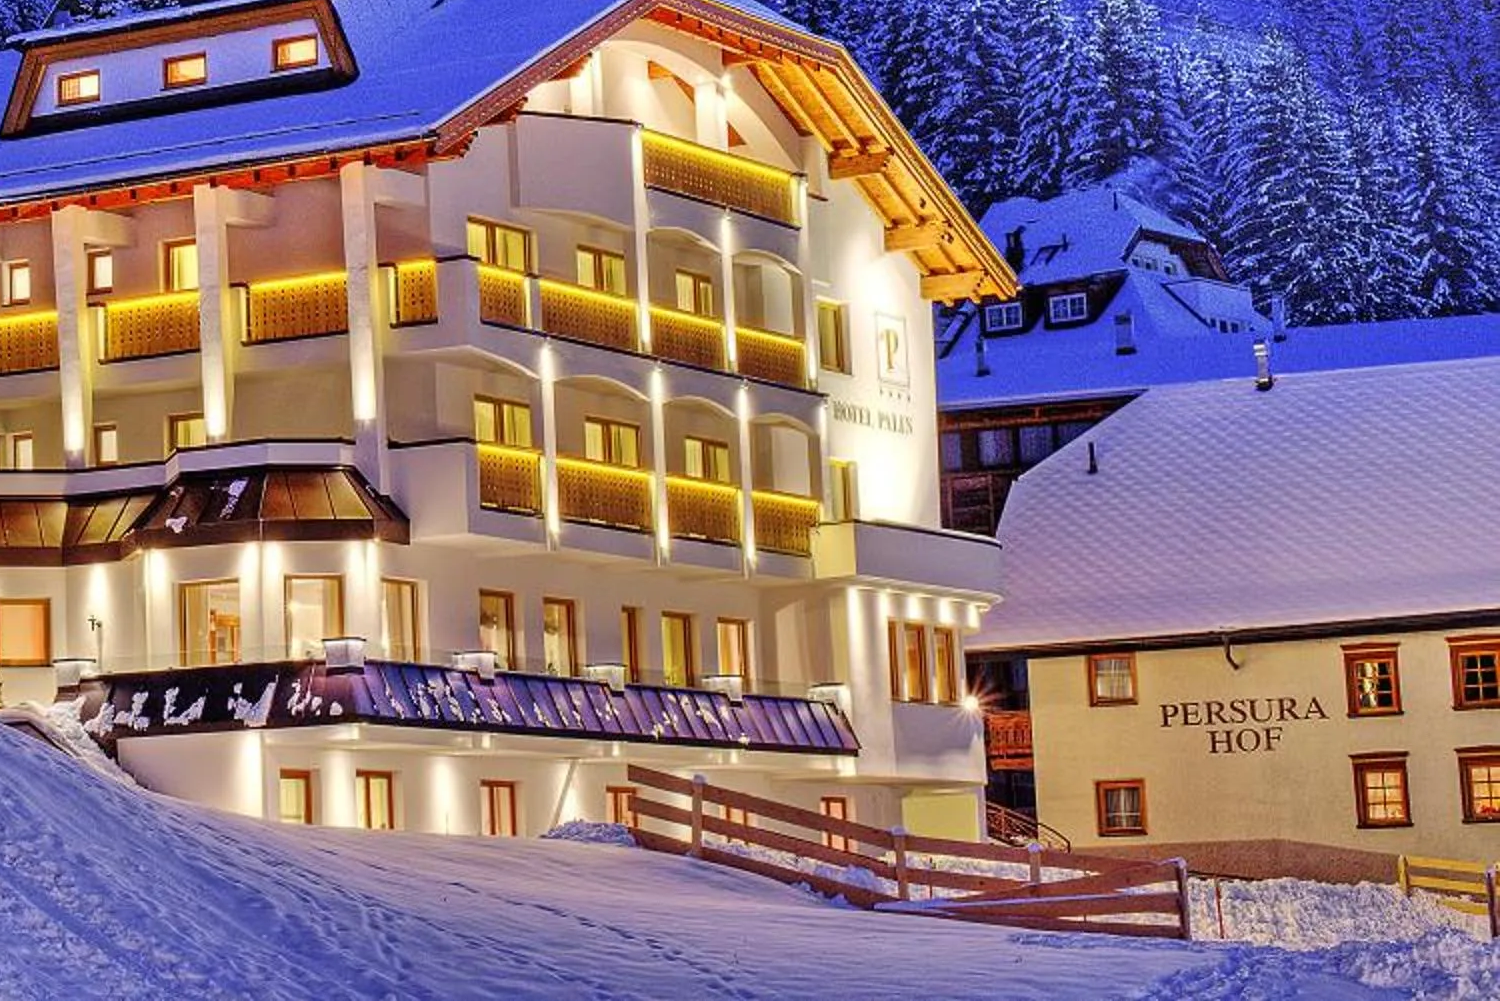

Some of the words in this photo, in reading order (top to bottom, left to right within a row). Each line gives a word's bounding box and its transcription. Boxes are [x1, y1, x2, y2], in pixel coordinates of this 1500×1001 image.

[832, 400, 871, 427] HOTEL
[1159, 696, 1330, 727] PERSURA
[1206, 726, 1284, 753] HOF
